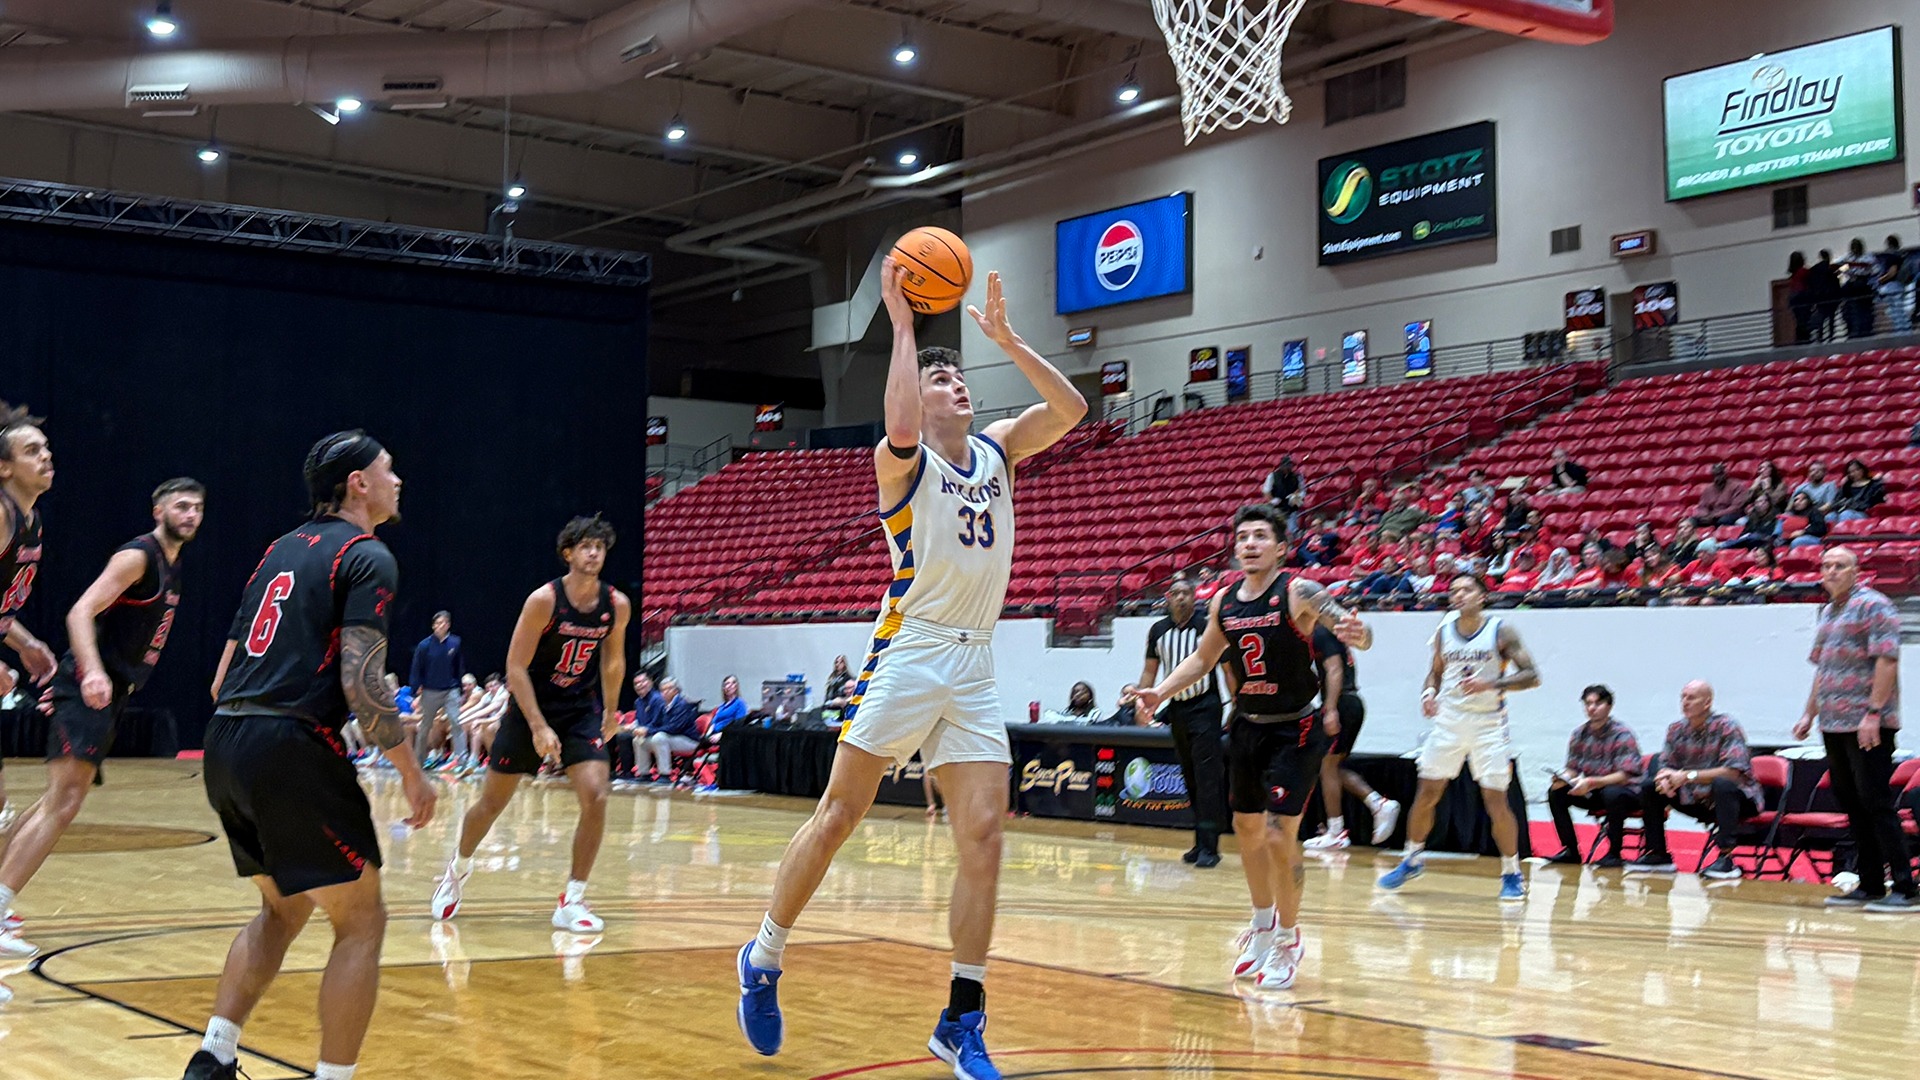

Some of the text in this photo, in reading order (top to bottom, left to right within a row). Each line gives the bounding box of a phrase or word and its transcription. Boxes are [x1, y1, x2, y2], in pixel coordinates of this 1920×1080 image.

[1718, 74, 1843, 128] Findlay
[1713, 118, 1834, 160] TOYOTA
[1676, 168, 1729, 188] BIGGER
[1729, 163, 1742, 178] &
[1743, 154, 1801, 176] BETTER
[1801, 145, 1844, 164] THAN
[1379, 173, 1485, 206] EQUIPMENT
[1099, 246, 1139, 267] PEPSI
[958, 505, 996, 550] 33
[245, 570, 295, 657] 6
[554, 638, 598, 676] 15
[1238, 633, 1266, 678] 2
